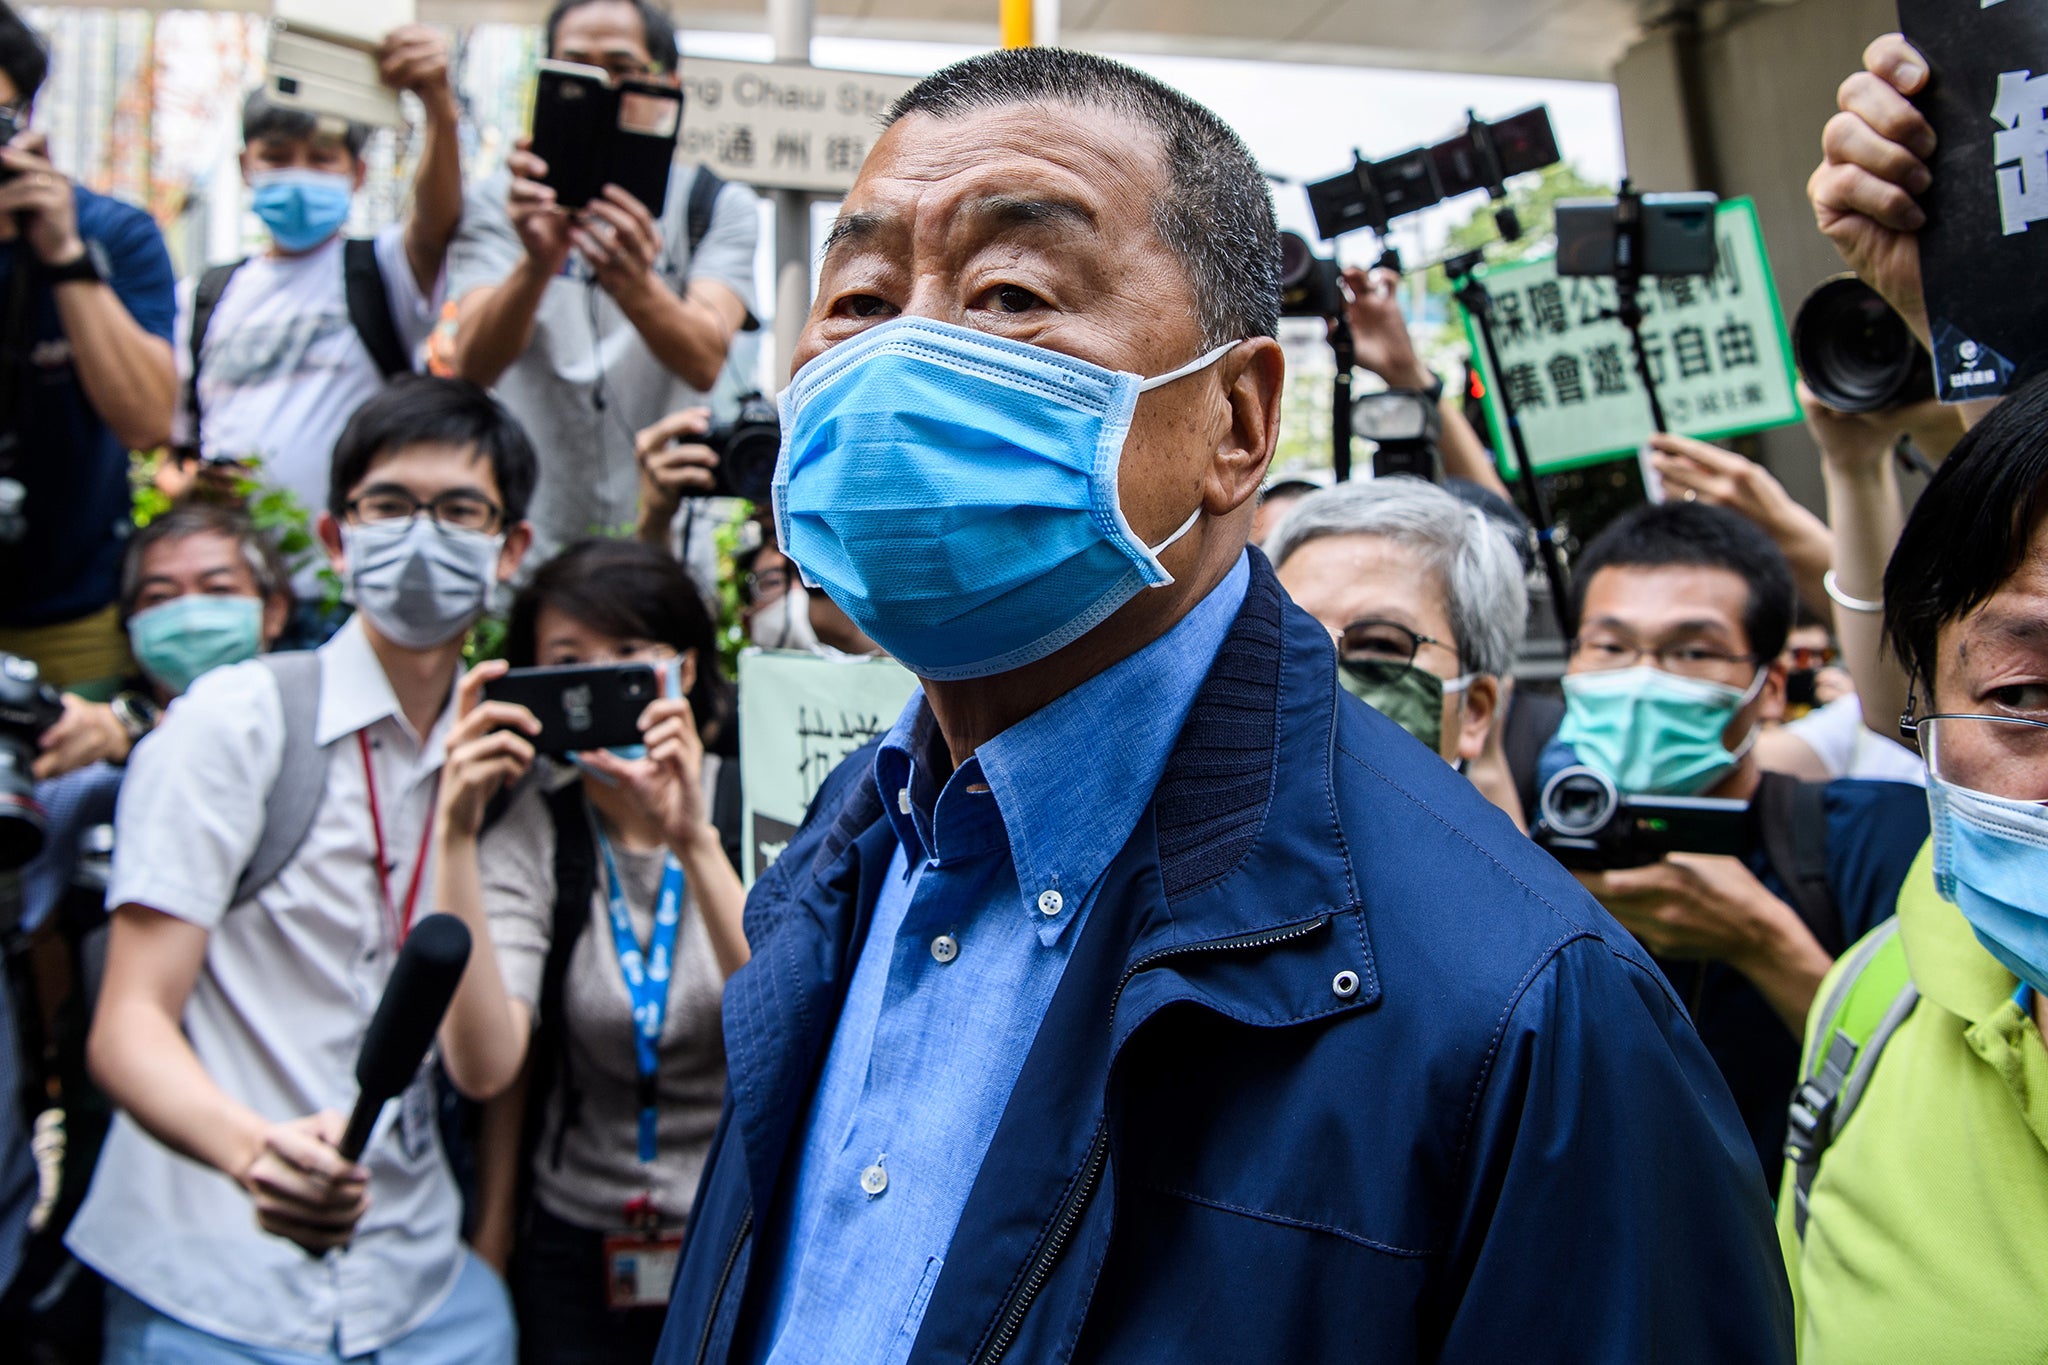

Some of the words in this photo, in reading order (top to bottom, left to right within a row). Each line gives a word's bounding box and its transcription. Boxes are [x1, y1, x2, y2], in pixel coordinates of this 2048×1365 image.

[732, 72, 826, 111] Chau
[836, 81, 888, 118] Str
[718, 122, 865, 173] 通州街
